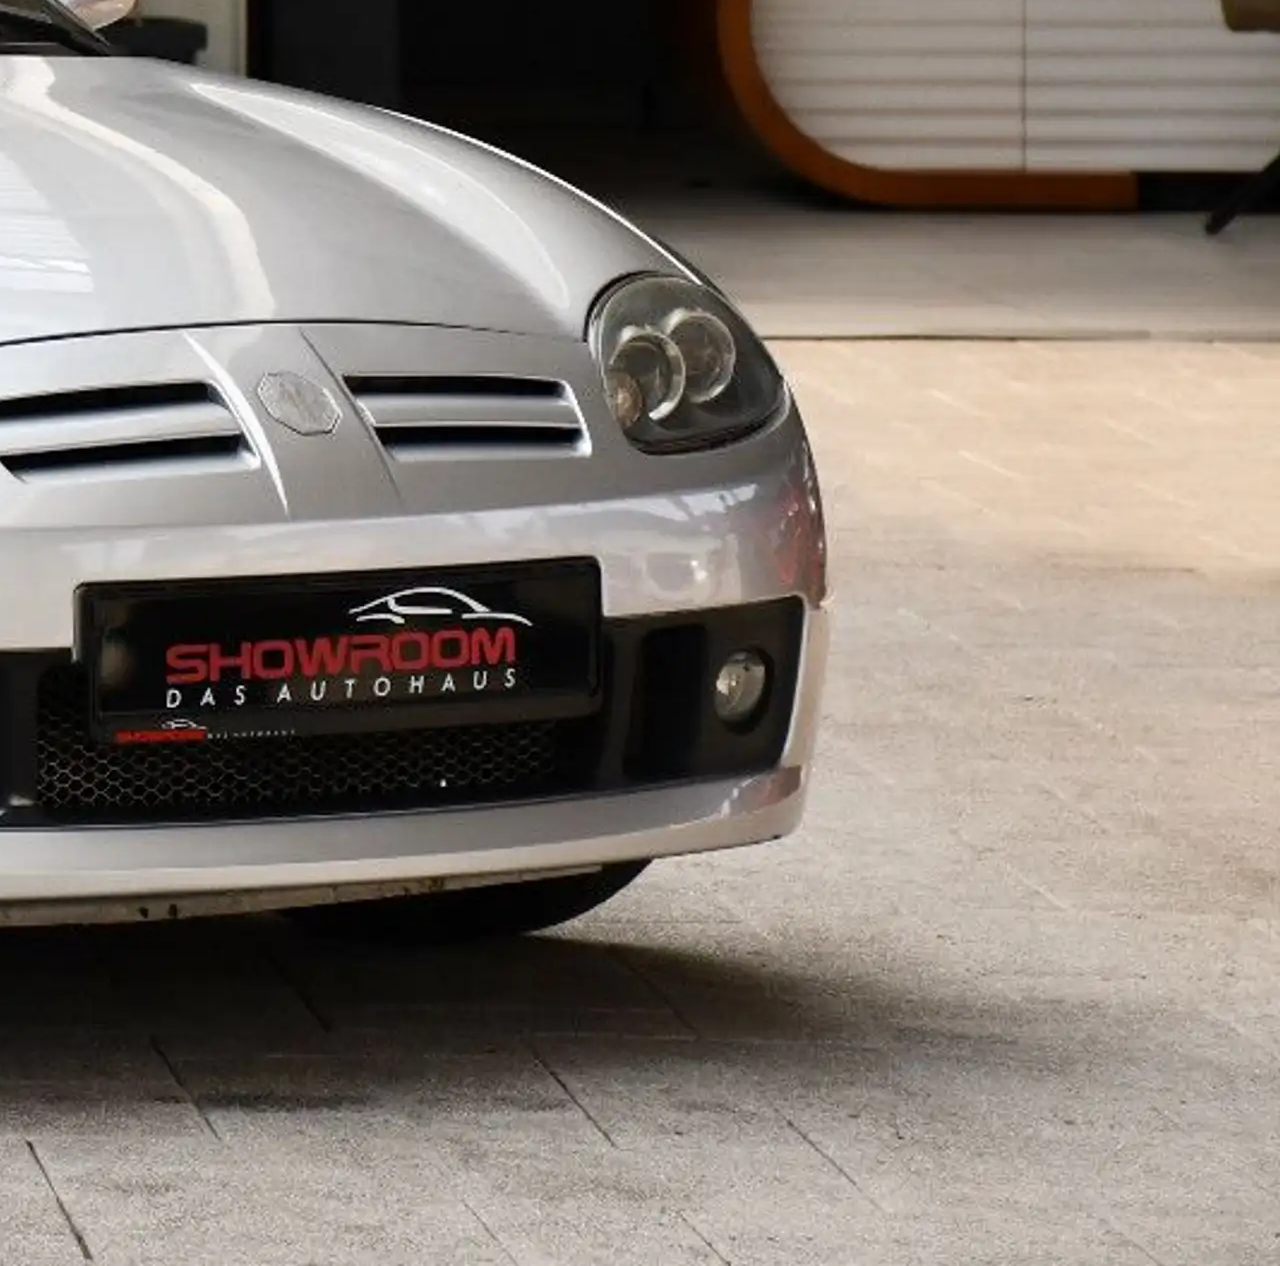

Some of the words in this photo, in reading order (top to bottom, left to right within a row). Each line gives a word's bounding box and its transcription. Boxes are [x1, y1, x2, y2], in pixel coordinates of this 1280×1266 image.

[166, 626, 517, 683] SHOWROOM
[166, 684, 246, 709] DAS
[276, 667, 517, 705] AUTOHAUS
